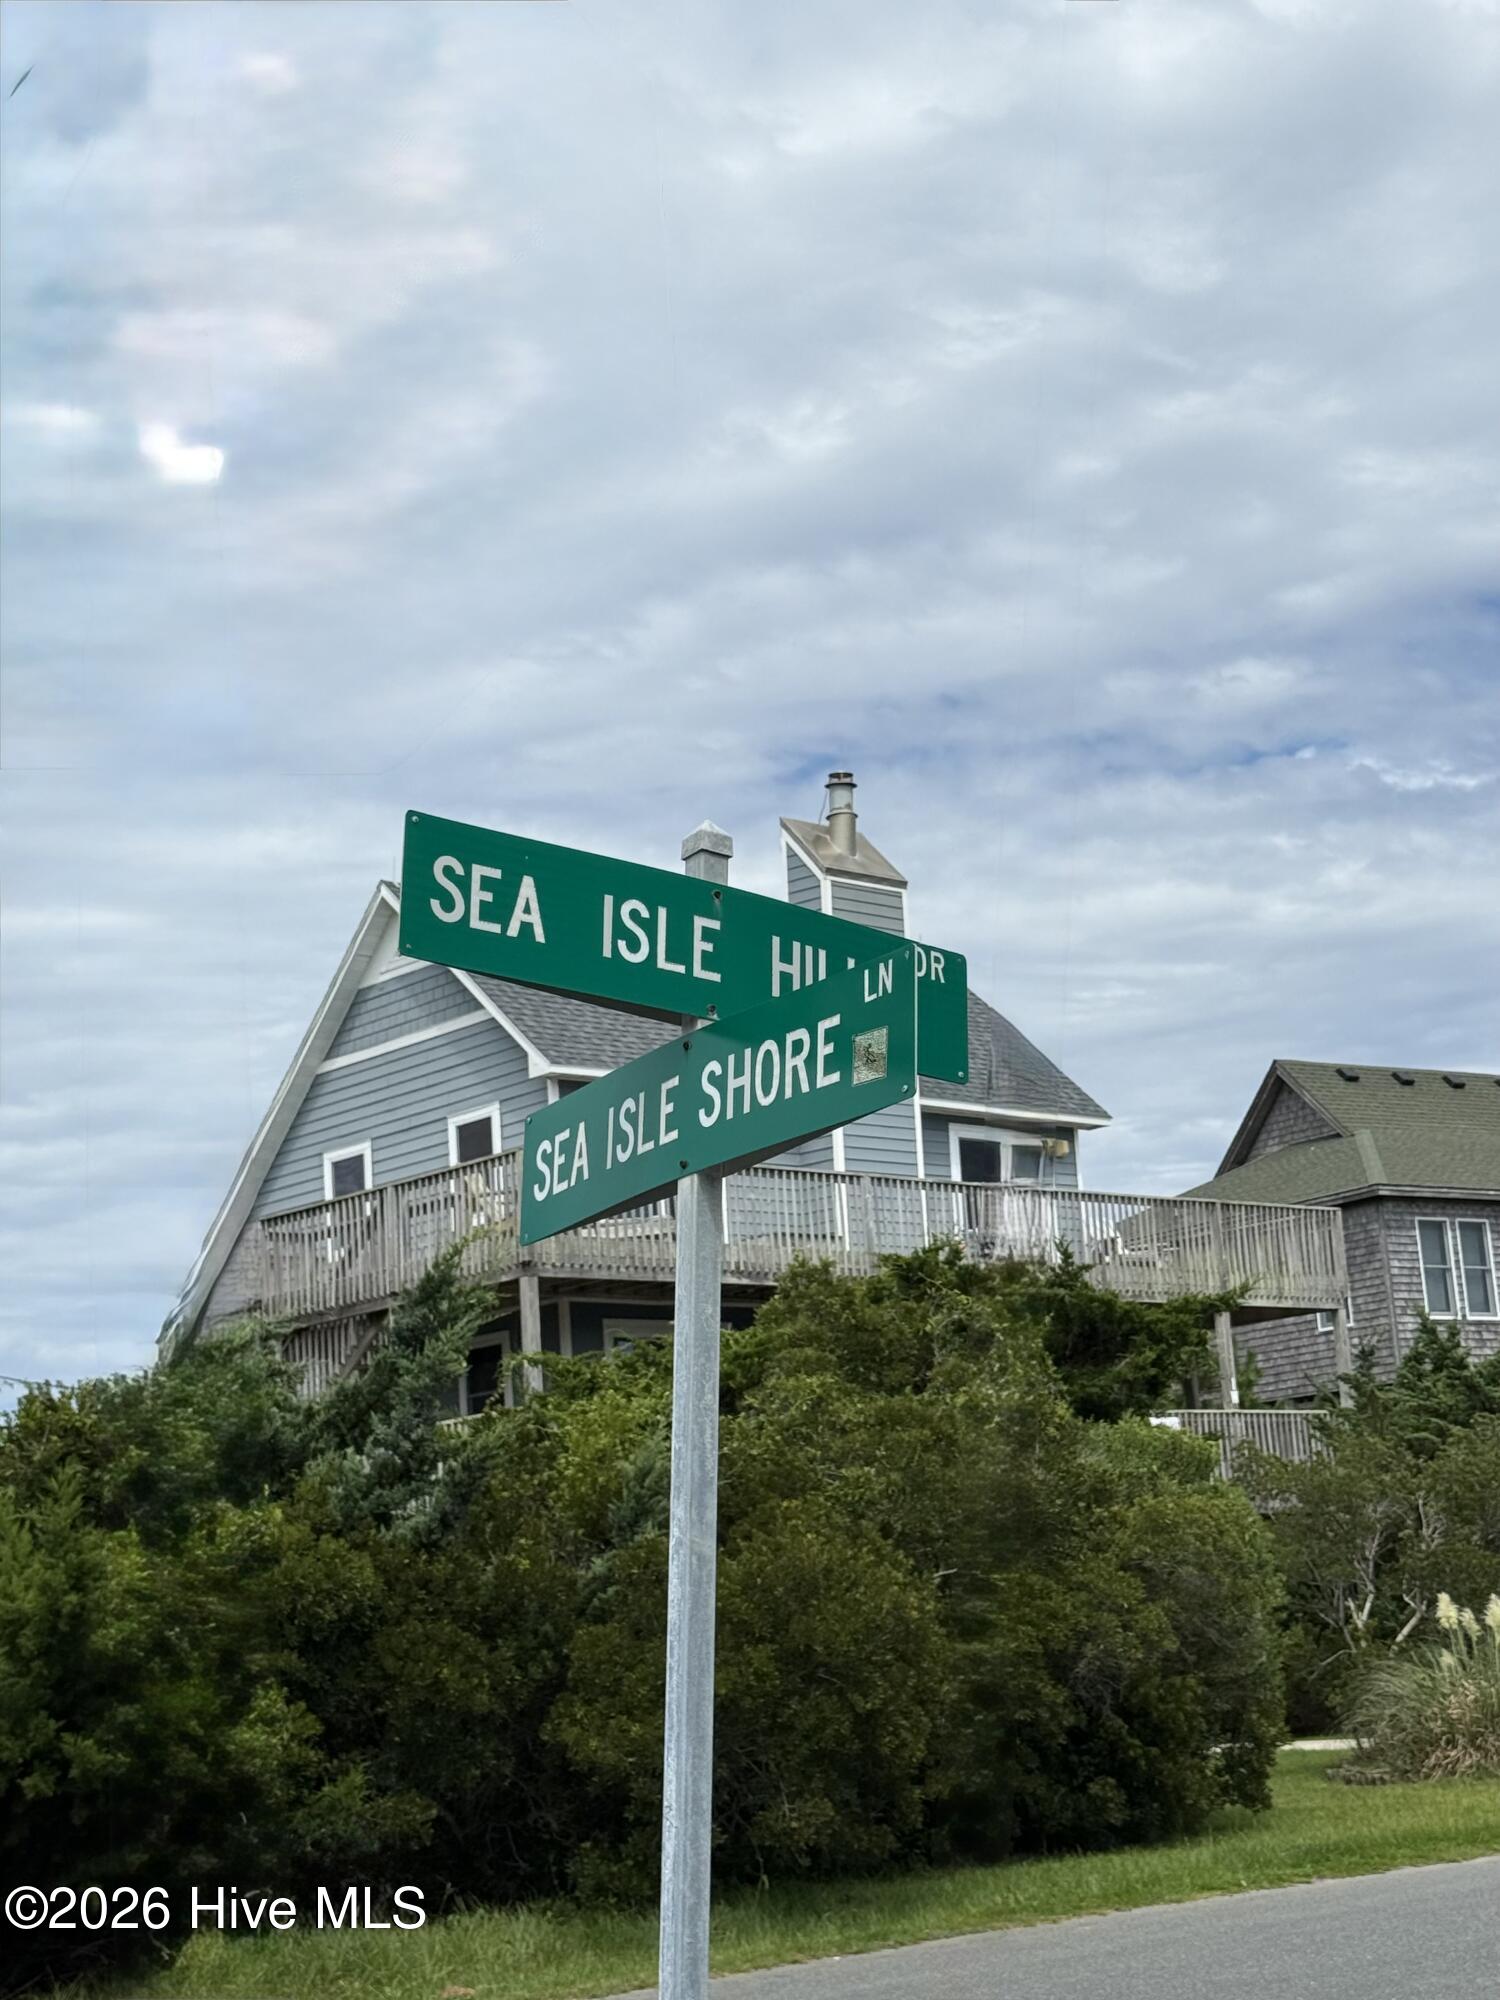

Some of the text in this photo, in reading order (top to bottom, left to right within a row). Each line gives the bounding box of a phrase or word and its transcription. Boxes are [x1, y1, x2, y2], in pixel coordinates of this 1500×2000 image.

[430, 855, 946, 998] SEA ISLE HI DR
[533, 959, 893, 1202] SEA ISLE SHORE LN
